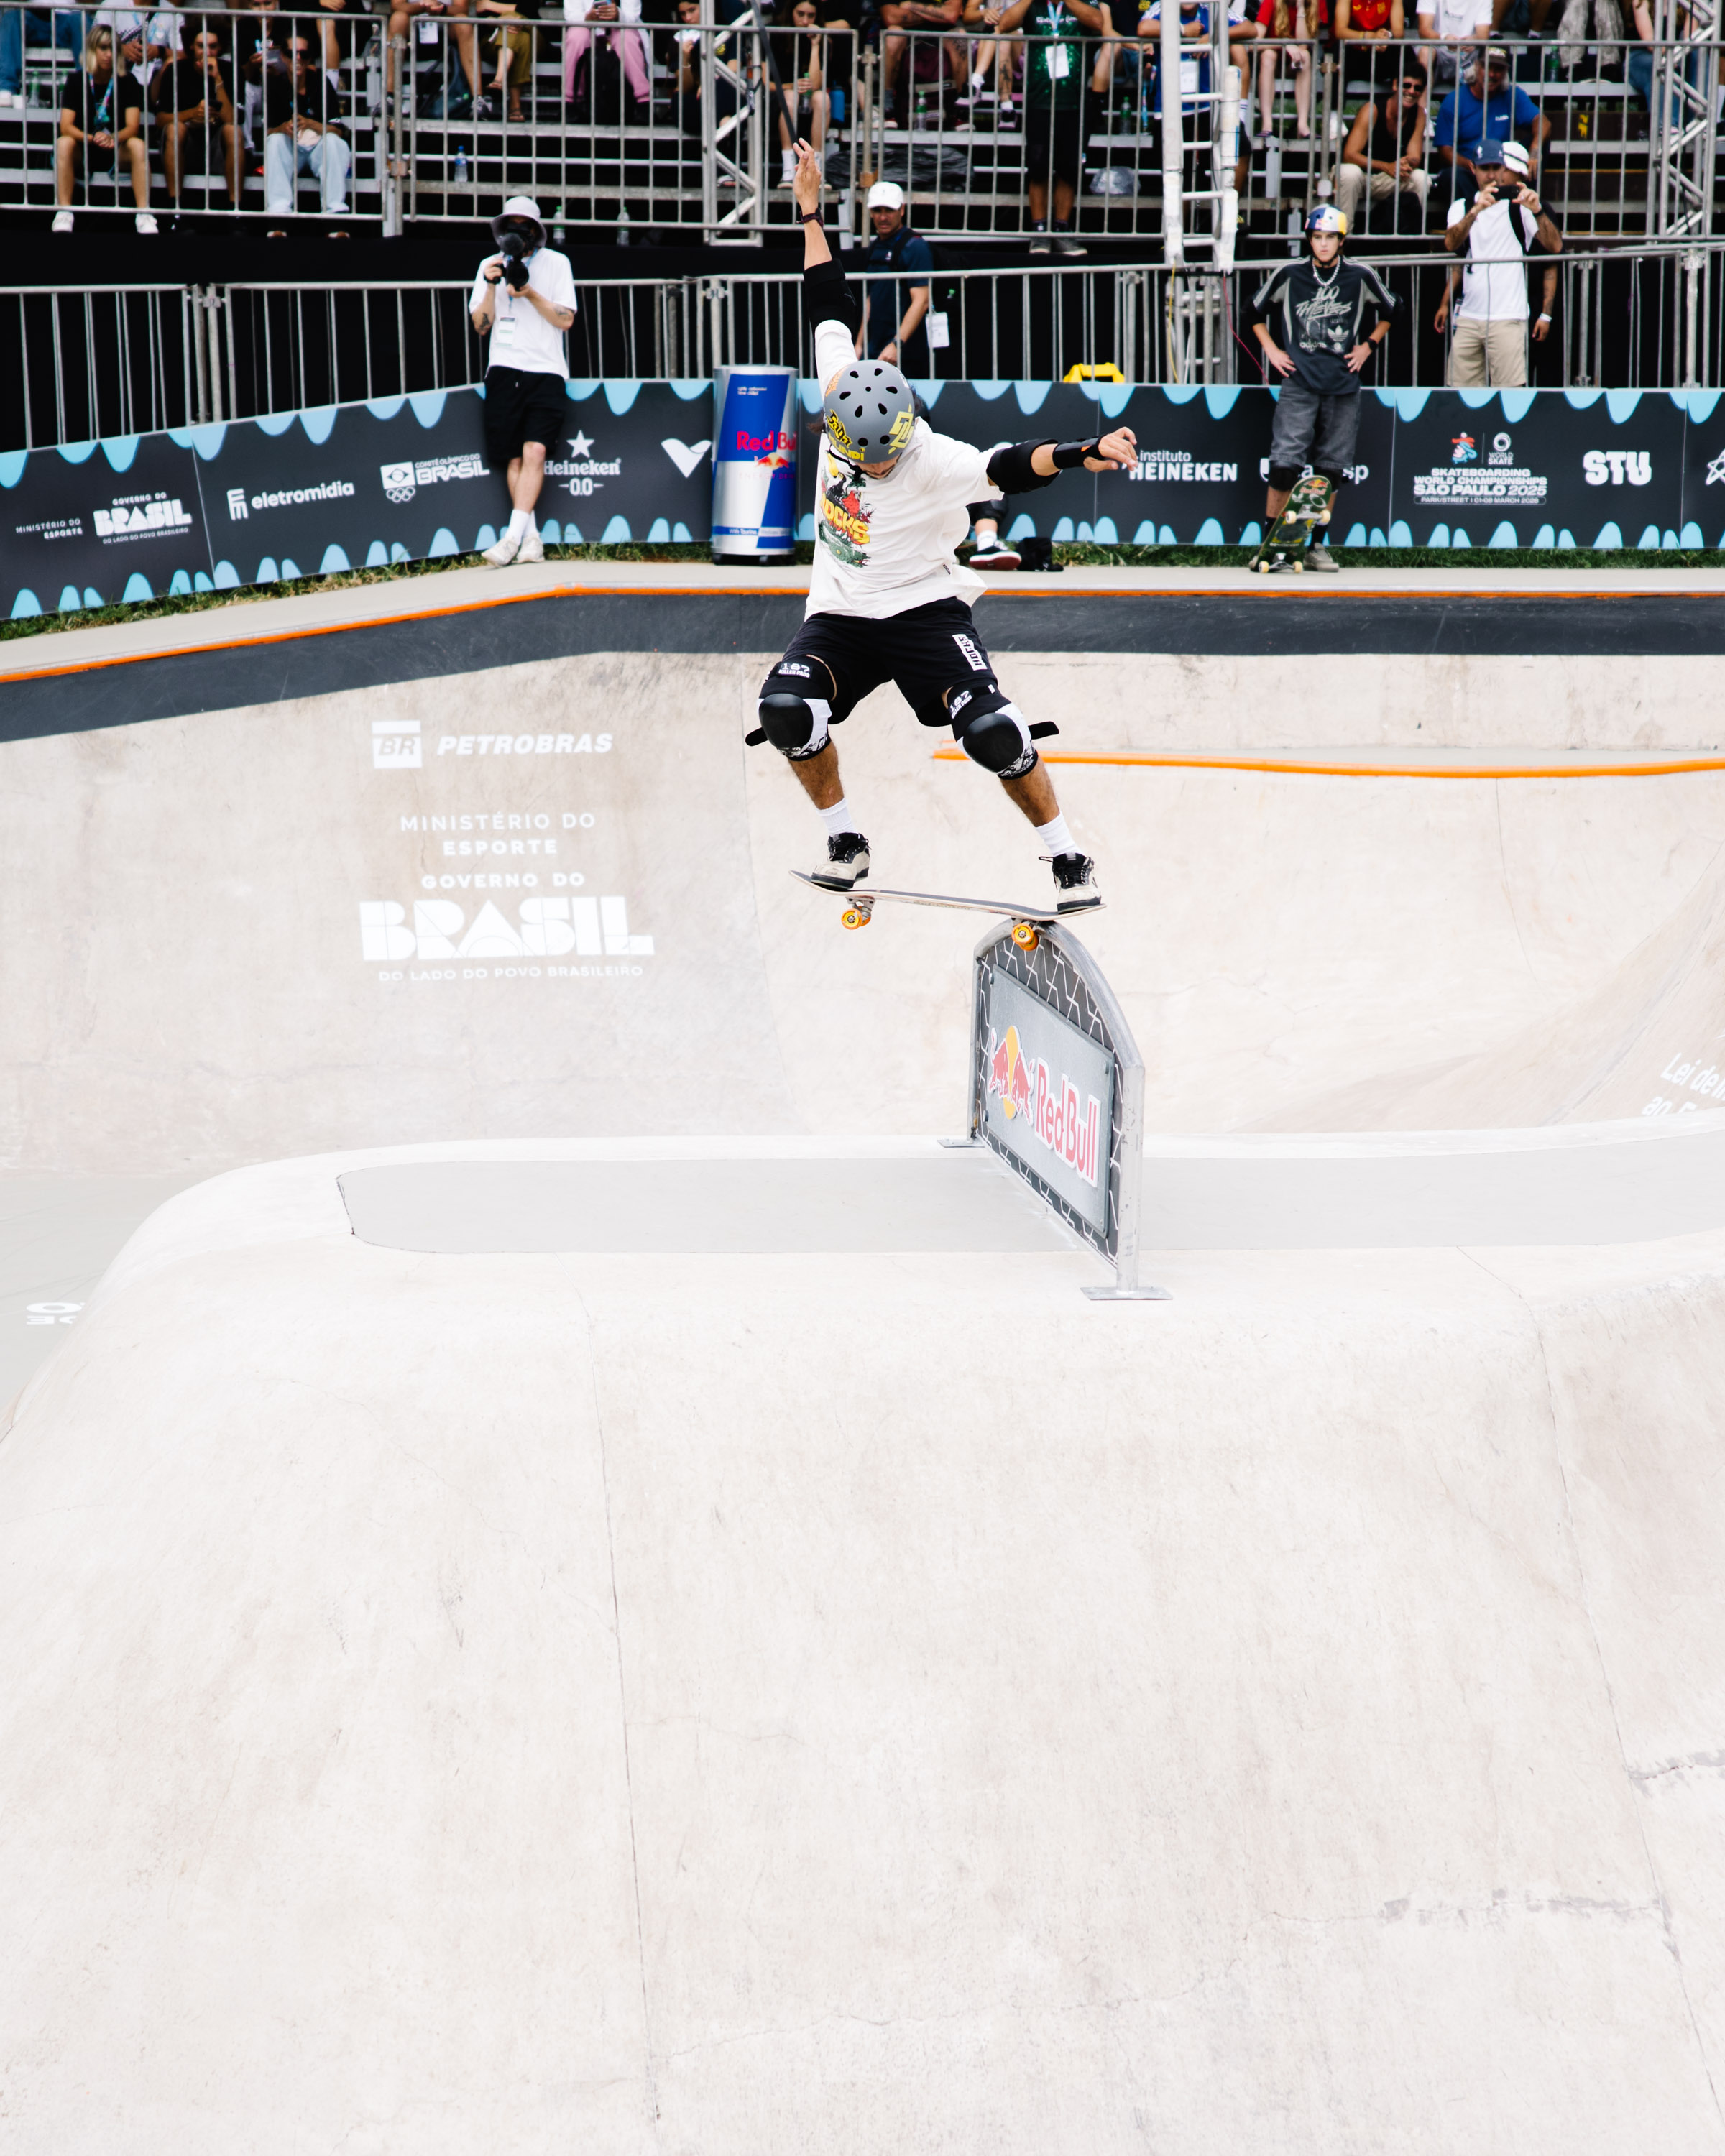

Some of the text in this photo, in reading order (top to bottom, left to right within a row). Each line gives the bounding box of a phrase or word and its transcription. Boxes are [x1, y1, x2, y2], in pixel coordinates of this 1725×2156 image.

[1311, 285, 1340, 302] 100
[1295, 300, 1353, 318] THIEVES
[736, 430, 774, 451] Red
[415, 457, 438, 469] COMITÊ
[439, 455, 469, 467] OLÍMPICO
[1140, 451, 1191, 463] instituto
[415, 459, 490, 485] BRASIL
[543, 459, 621, 476] Heineken
[1128, 463, 1238, 482] HEINEKEN
[1431, 468, 1531, 477] SKATEBOARDING
[1583, 450, 1652, 486] STU
[569, 477, 594, 497] 0.0
[1414, 476, 1548, 486] WORLD CHAMPIONSHIPS
[251, 480, 355, 510] eletromidia
[1414, 484, 1547, 496] SÃO PAULO 2025
[112, 493, 152, 506] GOVERNO
[16, 518, 81, 534] MINISTÉRIO DO
[93, 499, 193, 537] BRASIL
[44, 527, 83, 540] ESPORTE
[157, 527, 189, 537] BRASILEIRO
[782, 663, 810, 673] 187
[378, 733, 614, 756] BR PETROBRAS
[400, 811, 595, 831] MINISTÉRIO DO
[443, 839, 558, 856] ESPORTE
[420, 872, 585, 889] GOVERNO DO
[359, 895, 655, 961] BRASIL
[380, 965, 643, 982] DO LADO DO POVO BRASILEIRO
[1660, 1052, 1702, 1086] Lei
[1690, 1065, 1720, 1095] de
